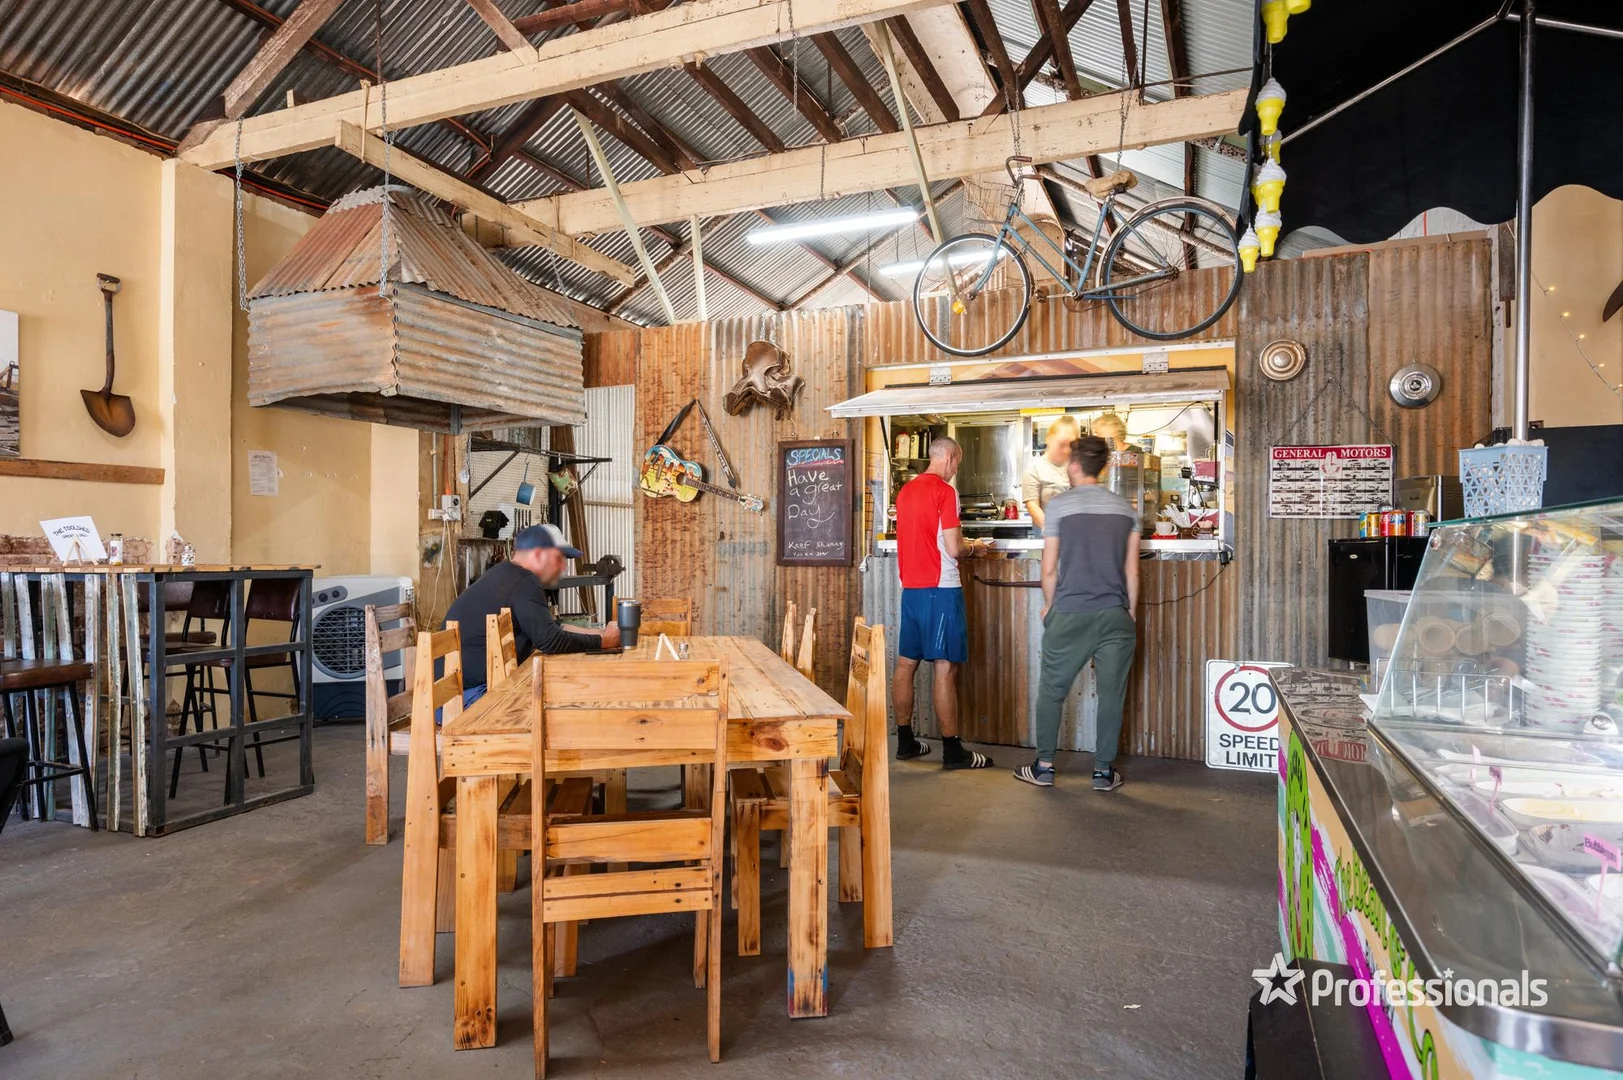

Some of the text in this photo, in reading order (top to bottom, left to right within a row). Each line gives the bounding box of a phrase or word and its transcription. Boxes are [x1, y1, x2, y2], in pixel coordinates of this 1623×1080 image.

[787, 448, 842, 466] SPECIALS
[1274, 448, 1387, 459] GENERAL MOTORS
[788, 469, 829, 486] Have
[790, 480, 843, 505] a great
[788, 504, 835, 529] Day
[1229, 681, 1277, 715] 20
[1219, 733, 1279, 751] SPEED
[1226, 750, 1276, 768] LIMIT
